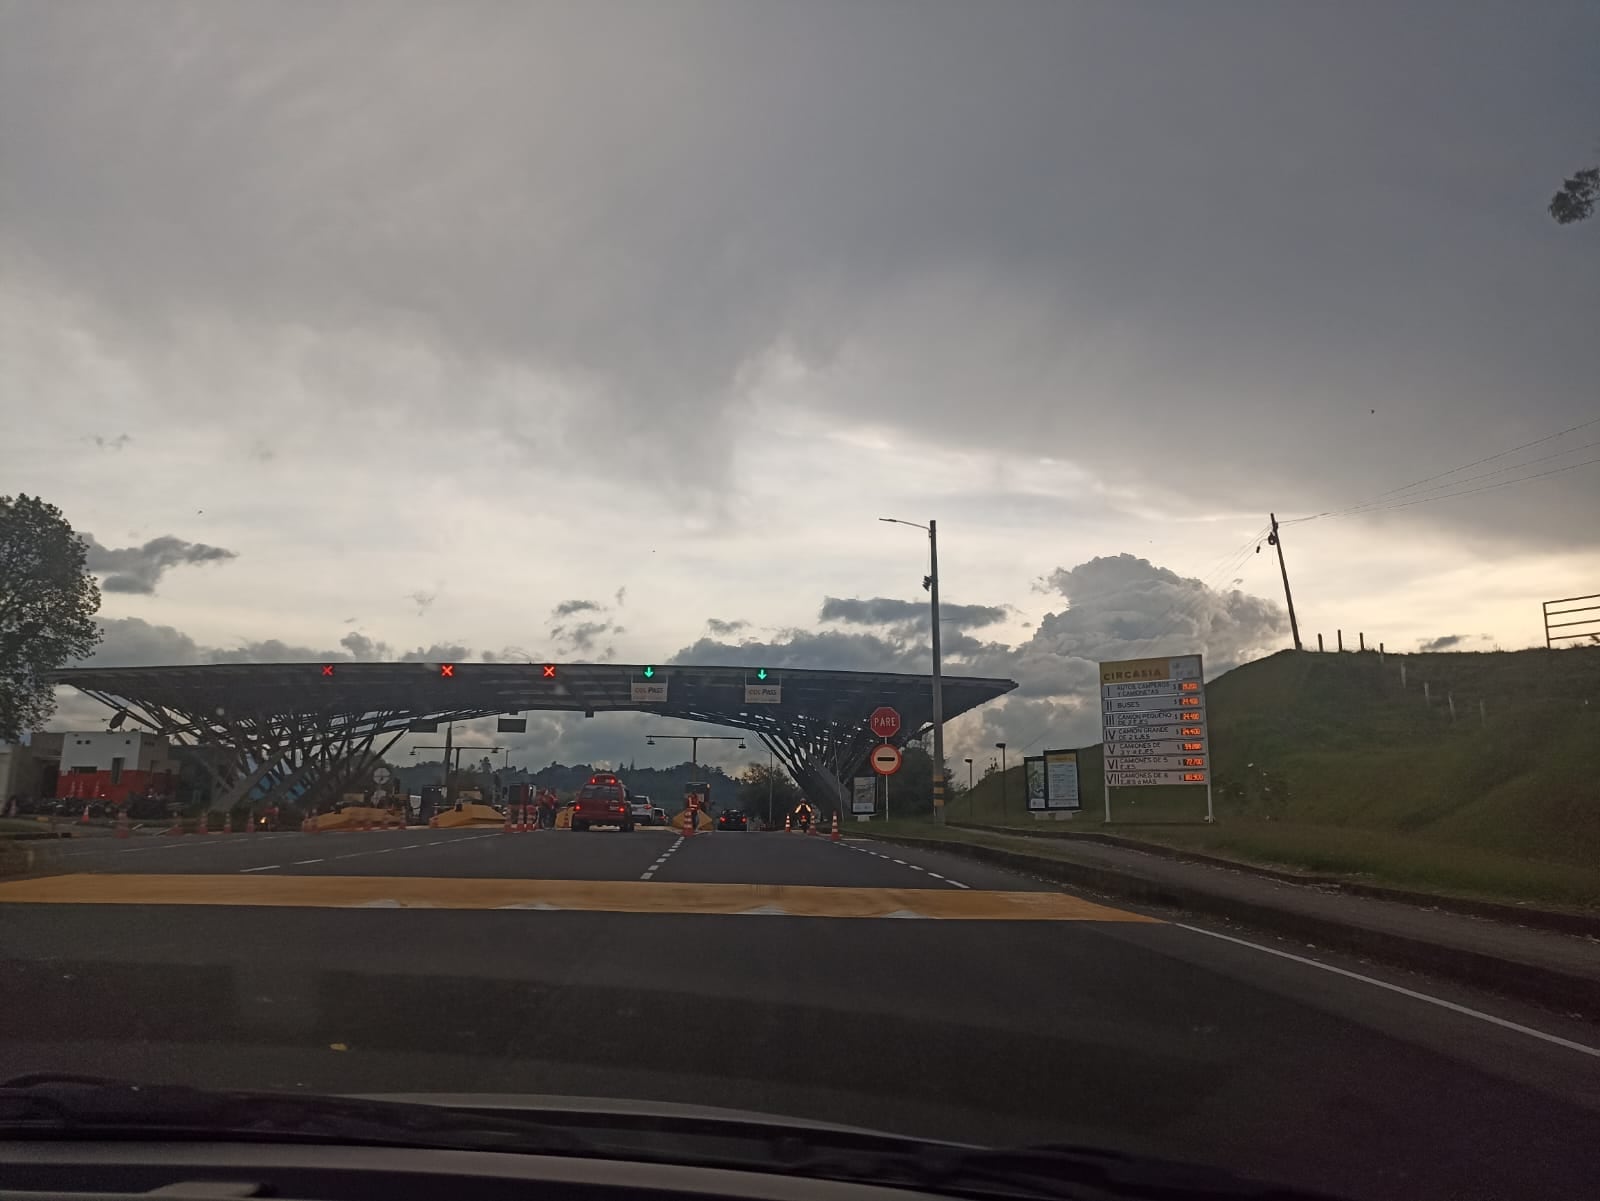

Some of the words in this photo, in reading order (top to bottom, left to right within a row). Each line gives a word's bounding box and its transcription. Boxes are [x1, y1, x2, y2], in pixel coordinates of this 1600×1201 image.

[1104, 669, 1161, 680] CIRCASIA
[874, 717, 896, 727] PARE
[1105, 730, 1116, 740] IV
[1108, 744, 1115, 754] V
[1107, 760, 1118, 769] VI
[1106, 774, 1120, 784] VII
